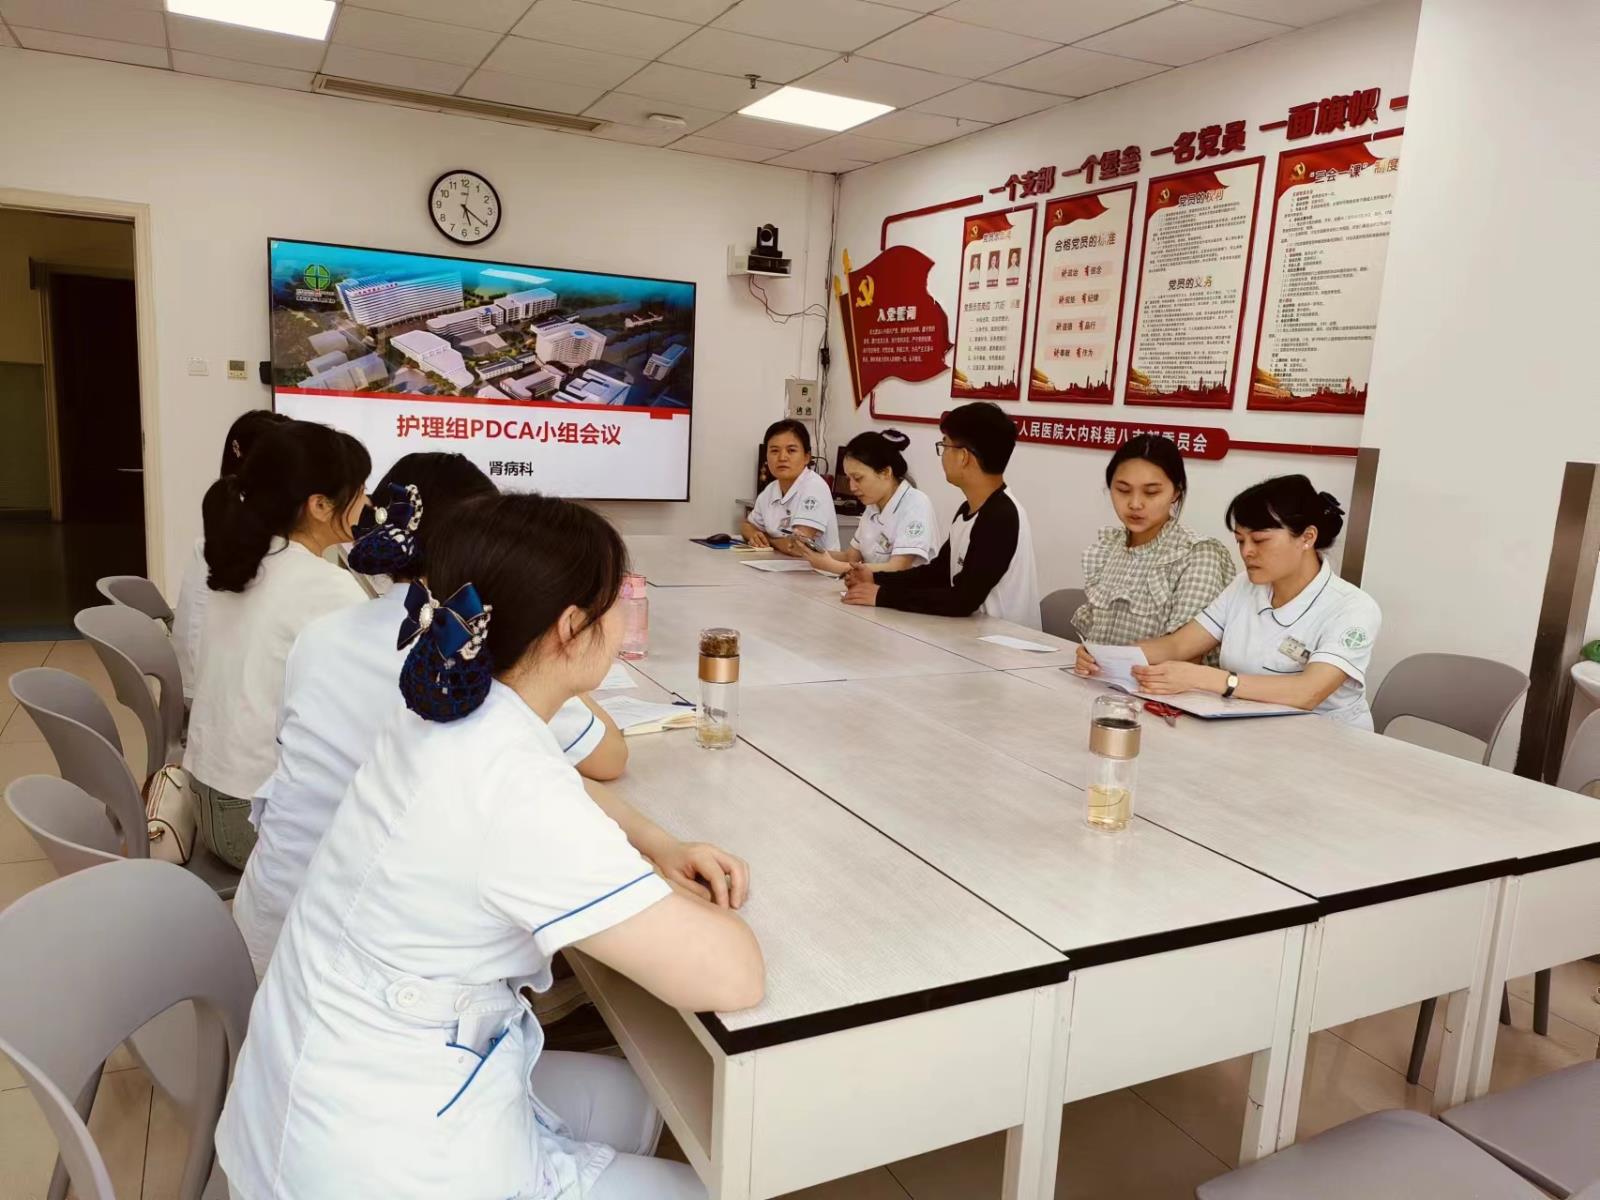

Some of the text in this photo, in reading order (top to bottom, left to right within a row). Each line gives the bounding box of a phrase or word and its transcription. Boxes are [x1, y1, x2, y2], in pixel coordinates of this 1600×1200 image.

[989, 165, 1057, 202] 一个支部
[1061, 145, 1142, 184] 一个堡垒
[1150, 120, 1247, 164] 一名党员
[1259, 87, 1381, 140] 一面旗帜
[449, 181, 457, 190] 11
[461, 179, 470, 188] 12
[440, 189, 449, 198] 10
[483, 195, 490, 204] 2
[436, 200, 442, 209] 9
[487, 207, 493, 216] 3
[440, 213, 446, 222] 8
[474, 227, 480, 236] 5
[1054, 232, 1116, 252] 合格党员的标准
[1168, 275, 1213, 290] 党员的义务
[396, 414, 622, 446] 护理组PDCA小组会议
[489, 460, 534, 477] 肾病科
